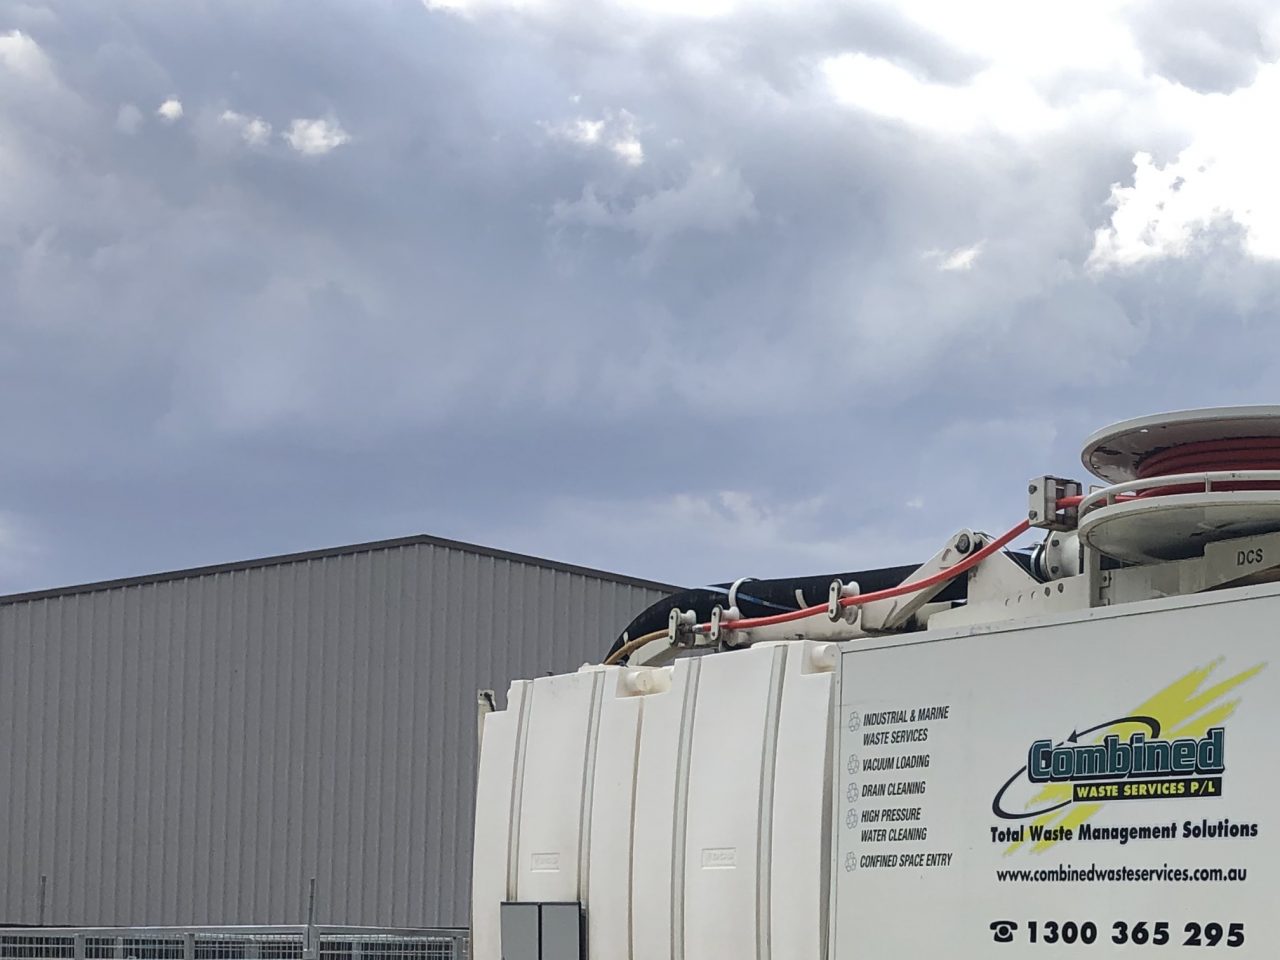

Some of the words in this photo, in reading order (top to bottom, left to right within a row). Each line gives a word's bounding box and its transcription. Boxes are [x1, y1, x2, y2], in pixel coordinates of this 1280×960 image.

[1237, 548, 1264, 566] DCS
[863, 710, 908, 726] INDUSTRIAL
[909, 709, 916, 722] &
[917, 705, 950, 721] MARINE
[863, 731, 890, 746] WASTE
[890, 728, 928, 744] SERVICES
[862, 757, 895, 772] VACUUM
[896, 754, 930, 770] LOADING
[1028, 727, 1225, 783] Combined
[861, 783, 886, 797] DRAIN
[887, 781, 926, 796] CLEANING
[1076, 785, 1119, 798] WASTE
[1124, 782, 1185, 797] SERVICES
[1190, 781, 1216, 795] P/L
[860, 809, 880, 823] HIGH
[880, 807, 921, 822] PRESSURE
[861, 828, 887, 842] WATER
[888, 827, 927, 841] CLEANING
[991, 825, 1024, 843] Total
[1029, 825, 1073, 842] Waste
[1078, 822, 1177, 844] Management
[1182, 819, 1258, 838] Solutions
[860, 854, 898, 868] CONFINED
[898, 853, 925, 867] SPACE
[925, 852, 953, 866] ENTRY
[996, 863, 1247, 882] www.combinedwasteservices.com.au
[1027, 921, 1097, 944] 1300
[1111, 921, 1170, 945] 365
[1182, 922, 1245, 947] 295
